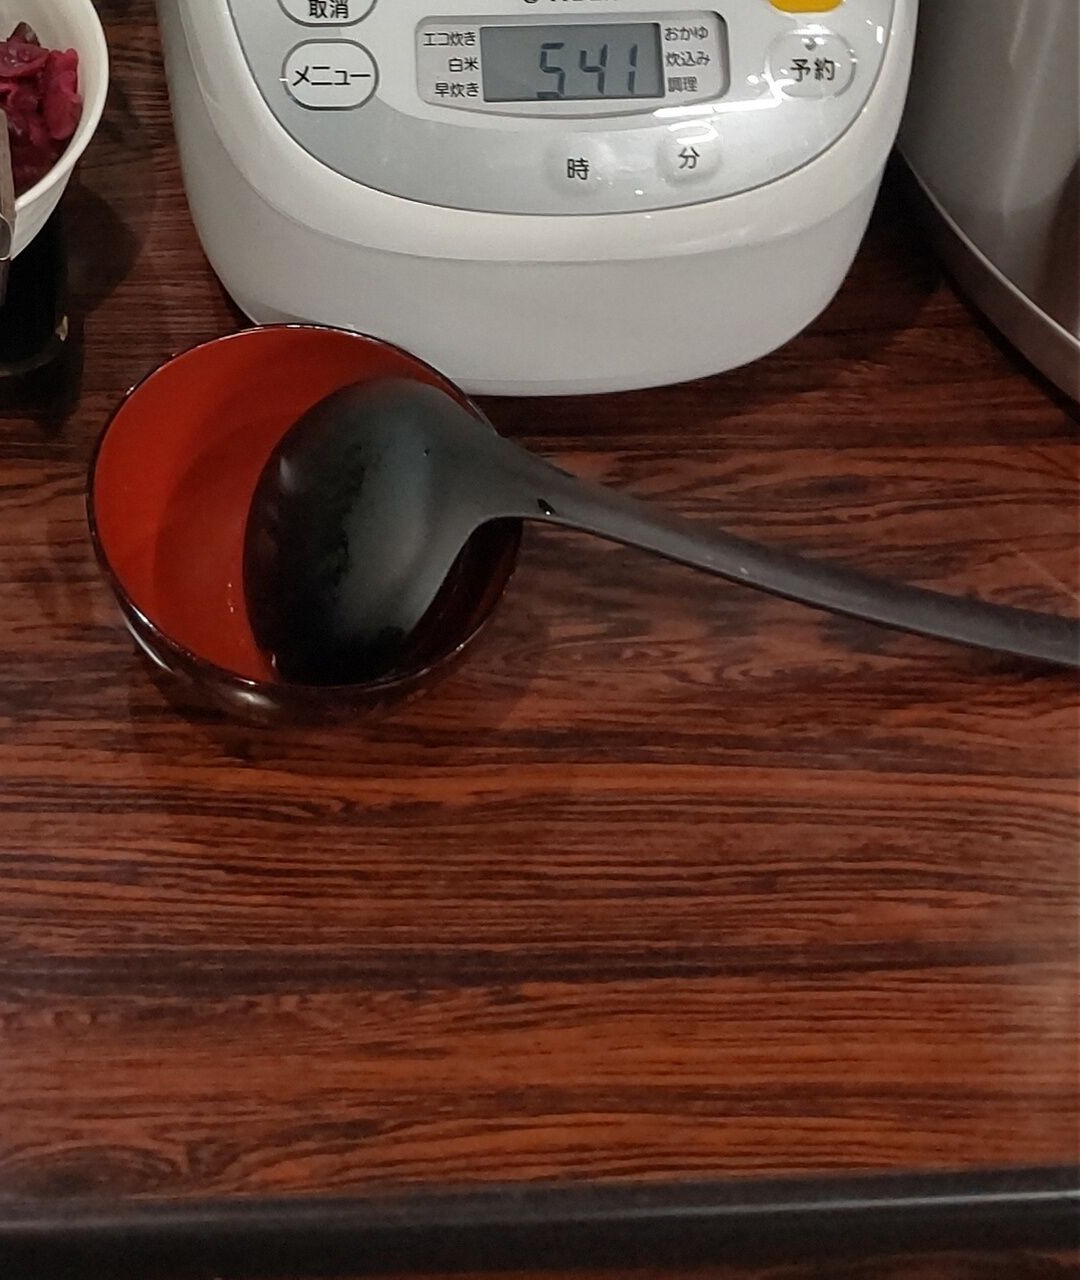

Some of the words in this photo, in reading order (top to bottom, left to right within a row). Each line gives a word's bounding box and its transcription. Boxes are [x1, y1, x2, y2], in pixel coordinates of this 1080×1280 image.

[423, 30, 476, 47] エコ炊き
[664, 27, 709, 41] おかゆ
[448, 57, 479, 72] 白米
[665, 50, 711, 67] 炊込み
[291, 63, 372, 88] メニュー
[789, 56, 837, 83] 予約
[434, 82, 480, 97] 早炊き
[677, 146, 701, 170] 分
[566, 156, 591, 182] 時
